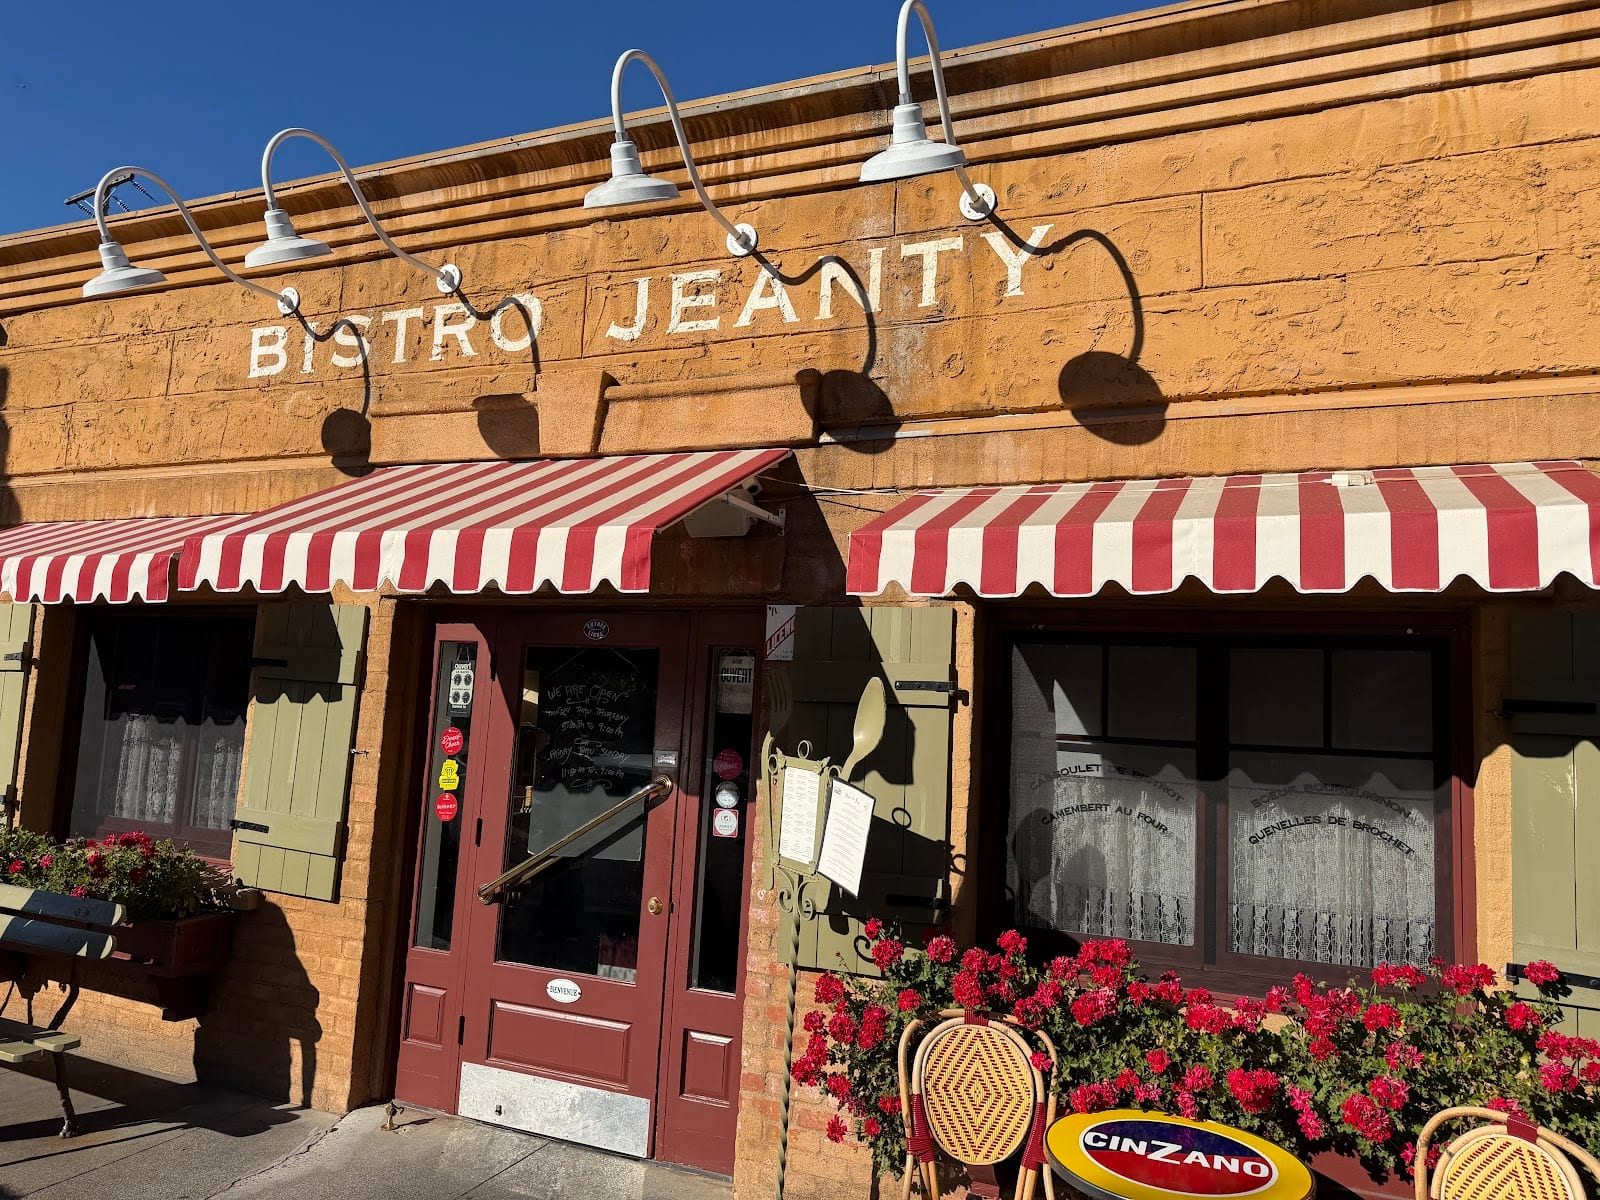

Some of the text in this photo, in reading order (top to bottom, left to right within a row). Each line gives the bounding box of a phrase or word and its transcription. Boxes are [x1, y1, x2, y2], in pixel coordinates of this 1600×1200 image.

[247, 223, 1055, 378] BISTRO JEANTY
[548, 684, 629, 703] WE ARE OPEN
[1041, 803, 1168, 834] CAMEMBERT AU FOUR
[1248, 815, 1415, 855] QUENELLES DE BROCHET
[1084, 1131, 1270, 1178] CINZANO
